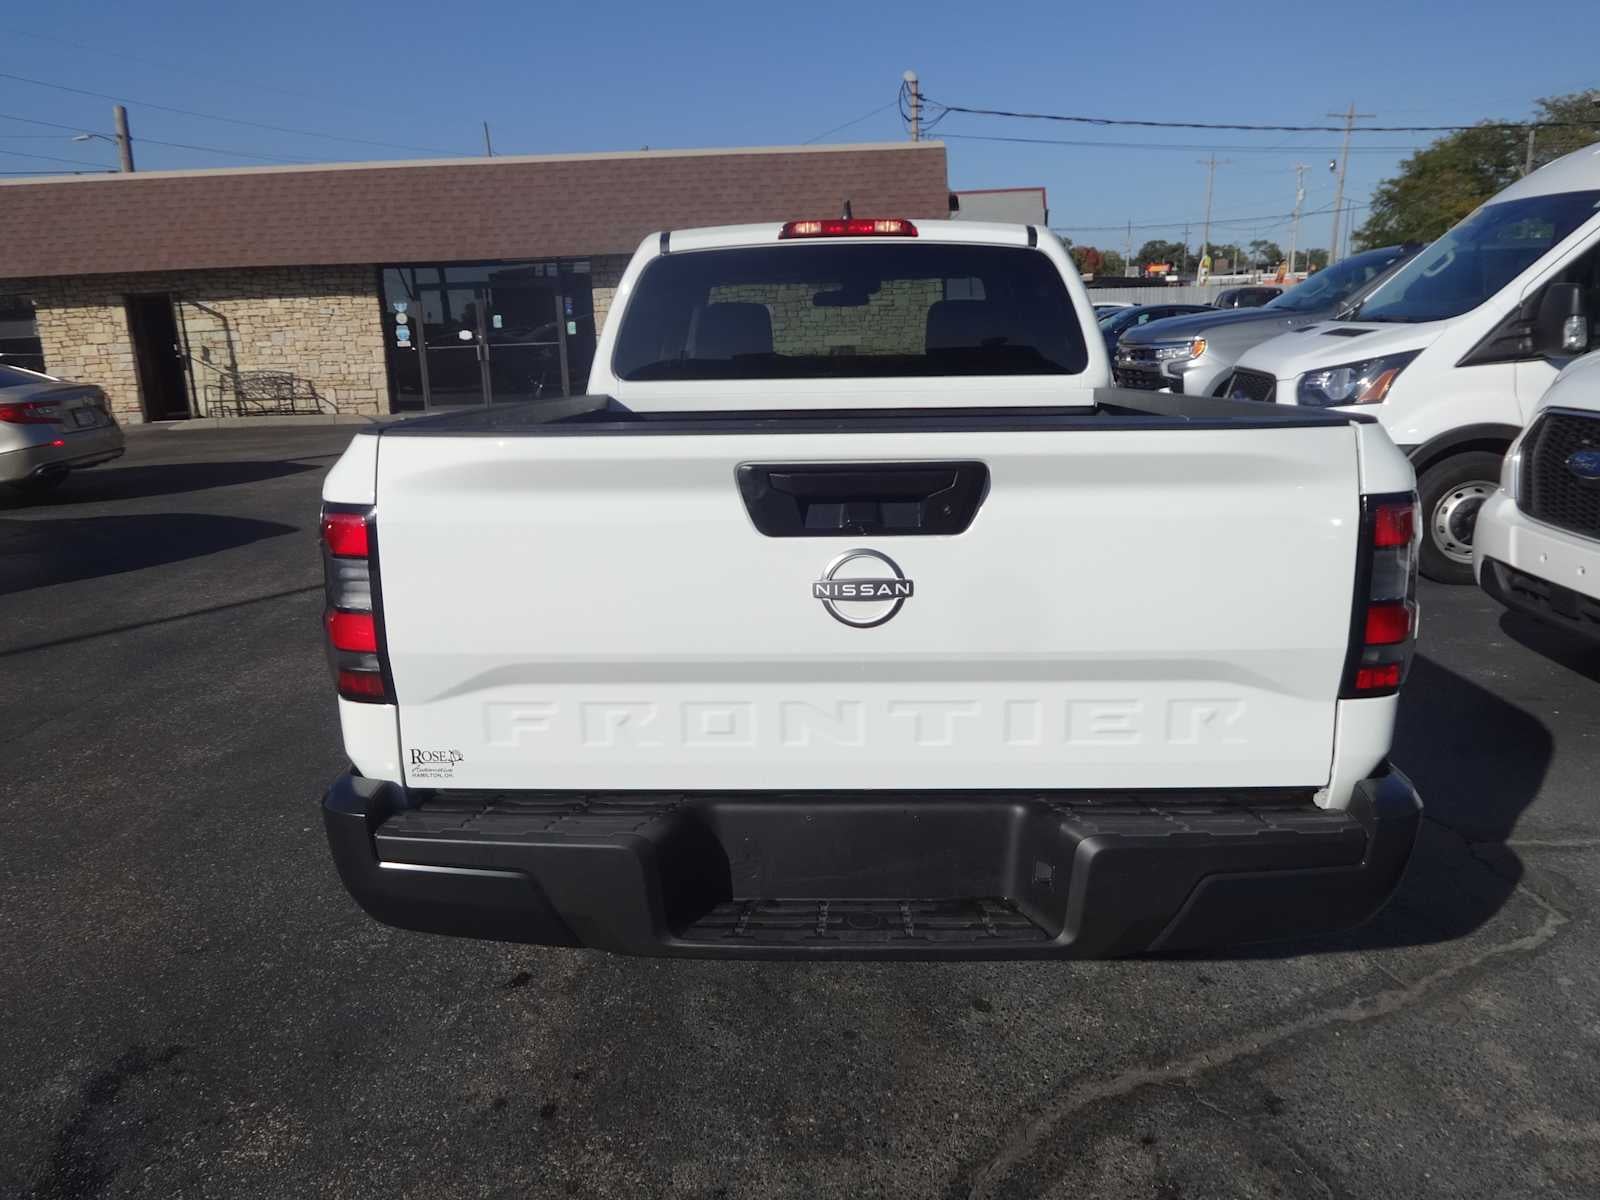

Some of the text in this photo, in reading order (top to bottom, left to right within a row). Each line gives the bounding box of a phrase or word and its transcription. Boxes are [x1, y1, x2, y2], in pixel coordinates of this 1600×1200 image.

[815, 583, 910, 596] NISSAN
[485, 700, 1248, 748] FRONTIER
[409, 748, 448, 764] ROSE
